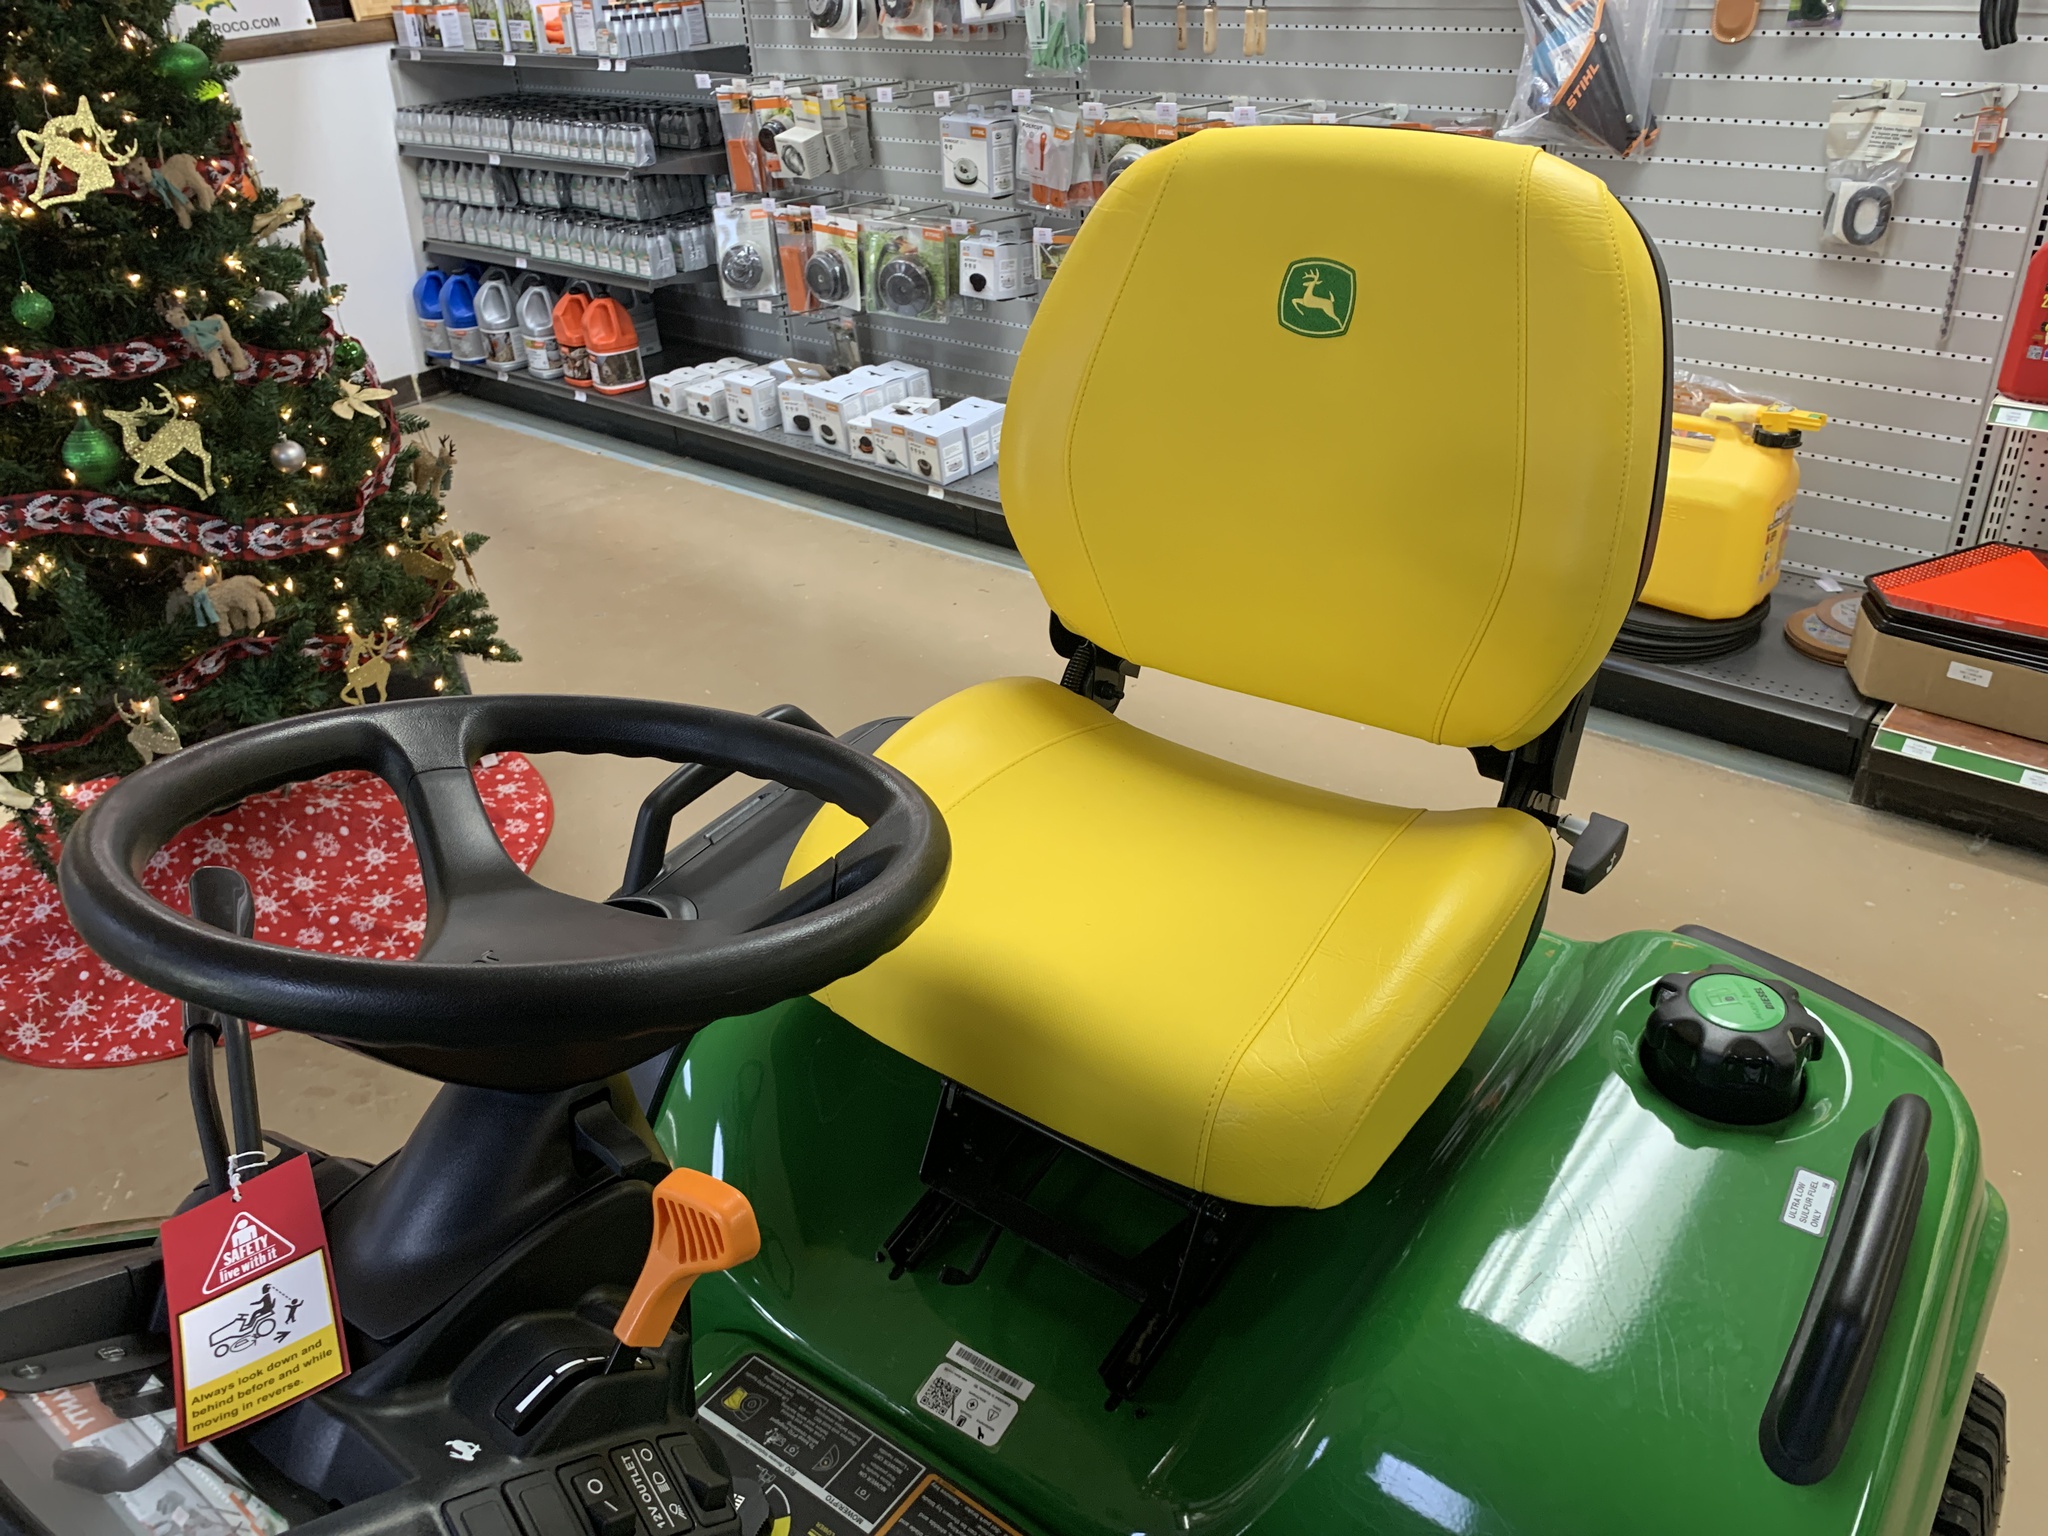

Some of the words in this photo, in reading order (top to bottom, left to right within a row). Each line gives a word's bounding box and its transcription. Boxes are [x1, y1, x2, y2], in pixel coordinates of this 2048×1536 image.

[1566, 63, 1600, 111] STIHL
[971, 129, 986, 137] STIHL
[1157, 128, 1175, 136] STIHL
[924, 231, 942, 239] STIHL
[1754, 987, 1776, 1010] DIESEL
[1788, 1197, 1801, 1220] ULTRA
[1795, 1182, 1806, 1198] LOW
[1799, 1197, 1813, 1224] SULFUR
[1808, 1180, 1819, 1198] FUEL
[1810, 1209, 1822, 1228] ONLY
[222, 1233, 269, 1267] SAFETY
[219, 1265, 241, 1283] live
[241, 1252, 266, 1274] with
[266, 1247, 278, 1264] it
[191, 1380, 235, 1405] Always
[238, 1367, 264, 1386] look
[266, 1351, 298, 1373] down
[301, 1338, 323, 1356] and
[192, 1395, 234, 1419] behind
[237, 1377, 275, 1399] before
[278, 1363, 300, 1381] and
[303, 1349, 333, 1369] while
[192, 1407, 239, 1432] moving
[242, 1400, 254, 1411] in
[256, 1380, 304, 1404] reverse.
[620, 1455, 652, 1503] OUTLET
[783, 1465, 796, 1476] RIO
[866, 1475, 887, 1492] MOWER
[648, 1506, 666, 1529] 12V
[824, 1494, 864, 1524] MOWER/PTO
[917, 1511, 929, 1522] and
[814, 1520, 835, 1536] LOWER
[898, 1517, 909, 1527] and
